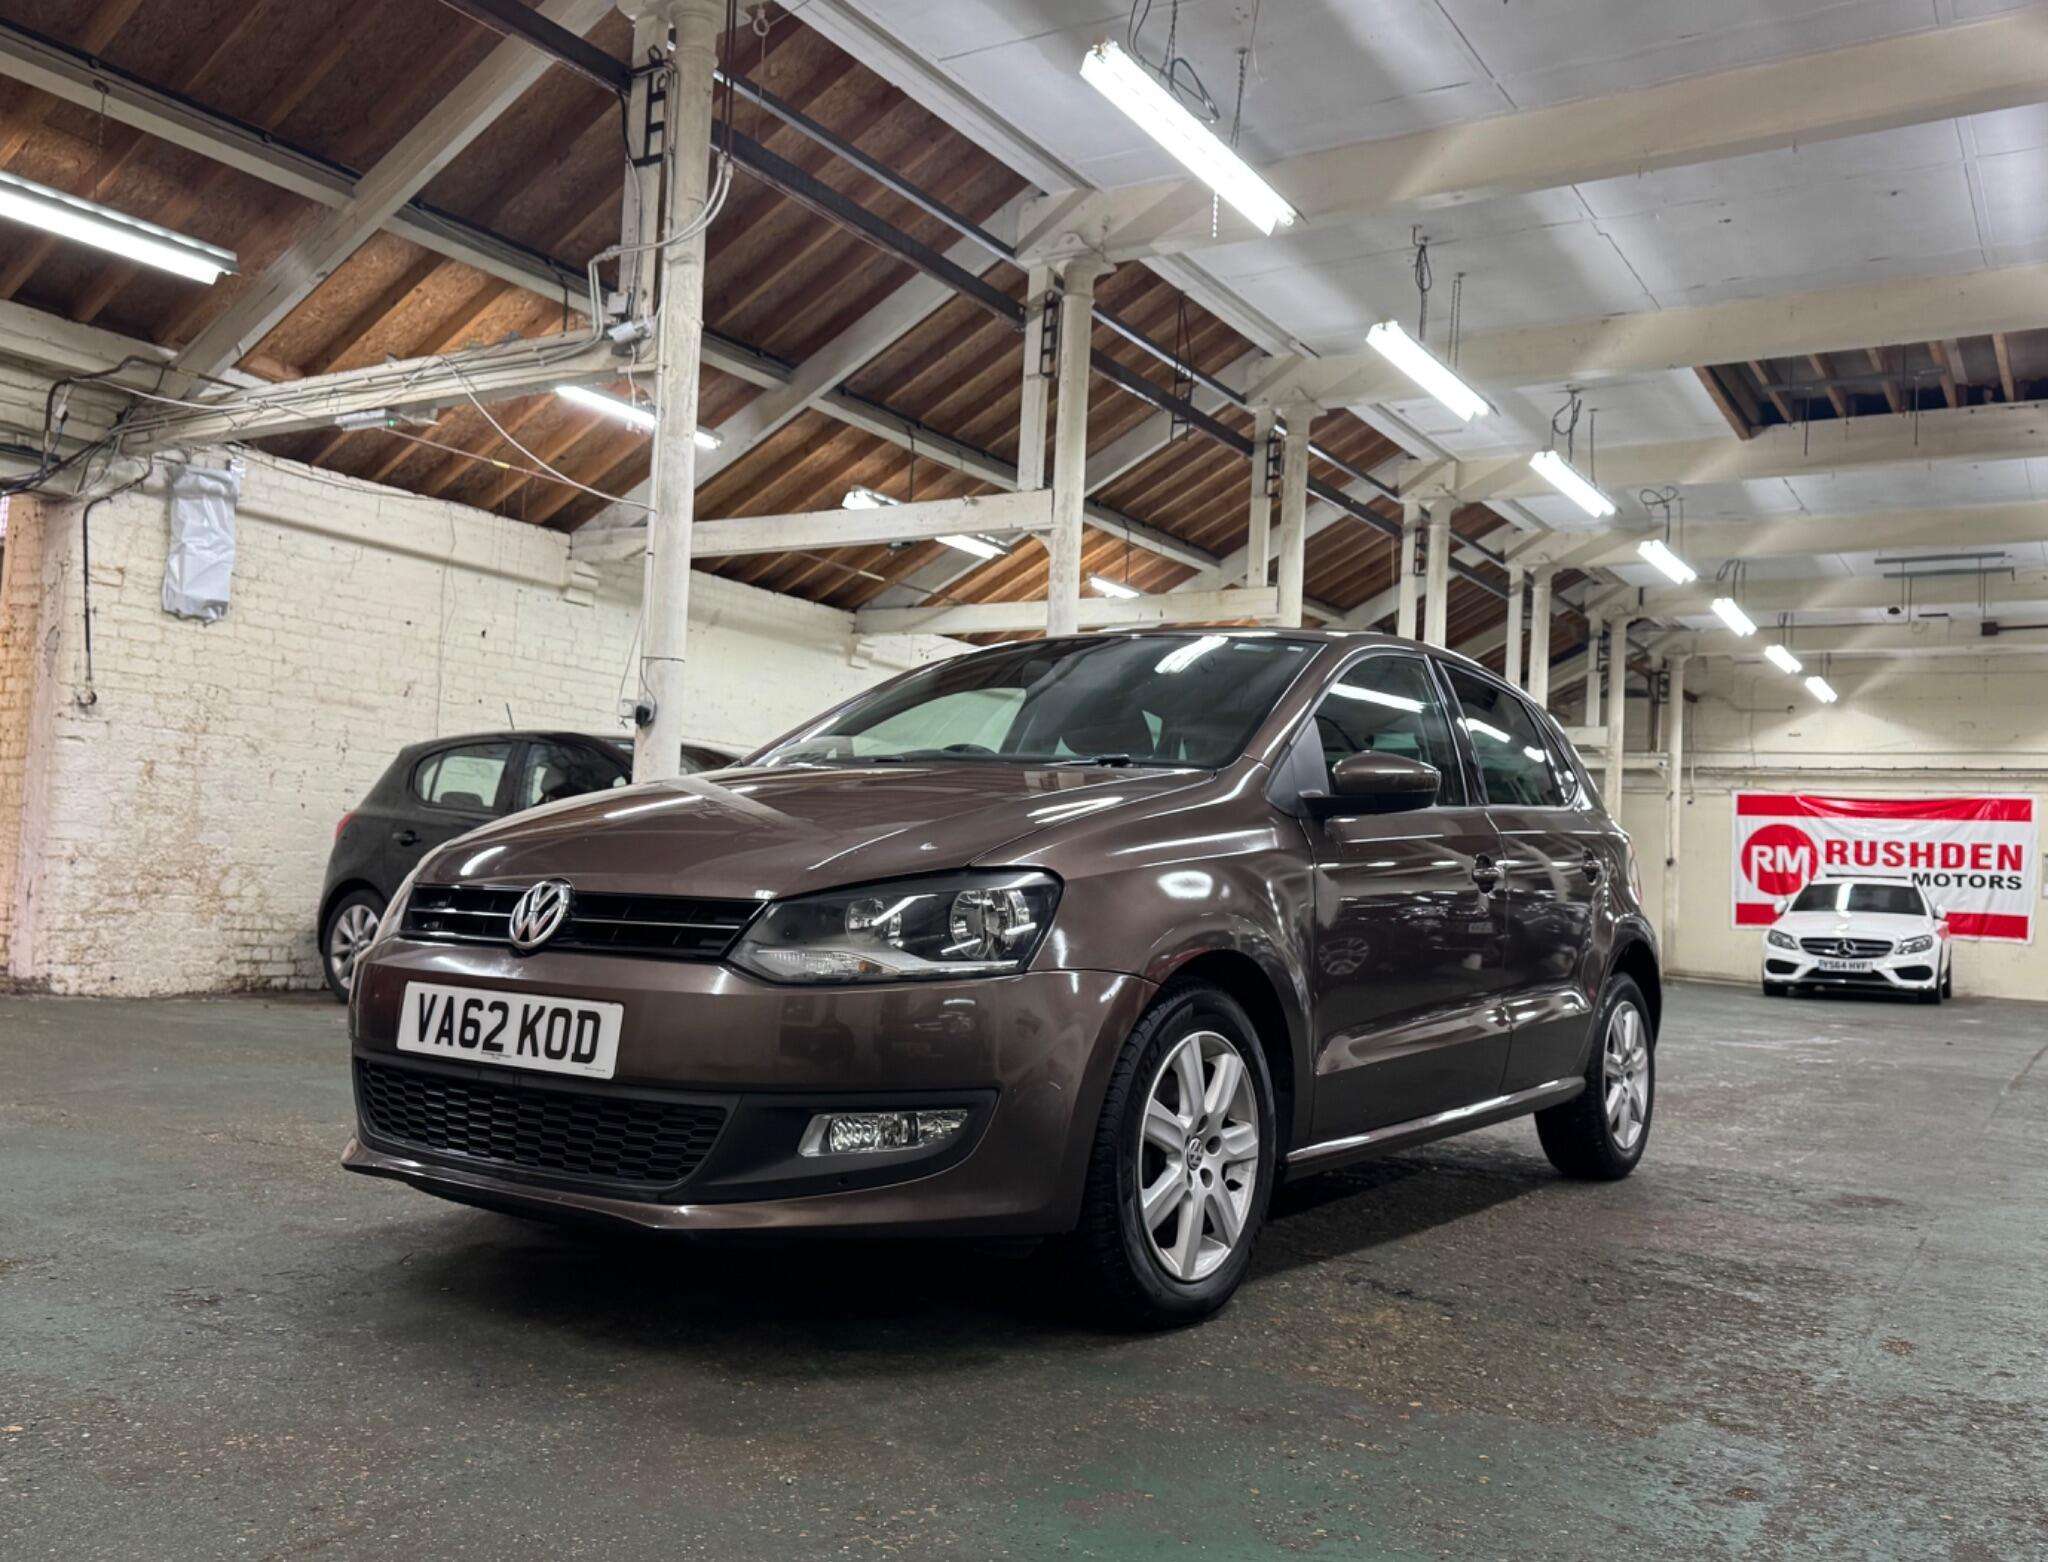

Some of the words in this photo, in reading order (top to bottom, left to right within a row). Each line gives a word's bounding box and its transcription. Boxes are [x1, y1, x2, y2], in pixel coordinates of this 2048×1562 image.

[1750, 844, 1810, 881] RM
[1824, 839, 2023, 871] RUSHDEN
[1911, 872, 2022, 891] MOTORS
[417, 992, 510, 1053] VA62
[516, 1003, 601, 1064] KOD
